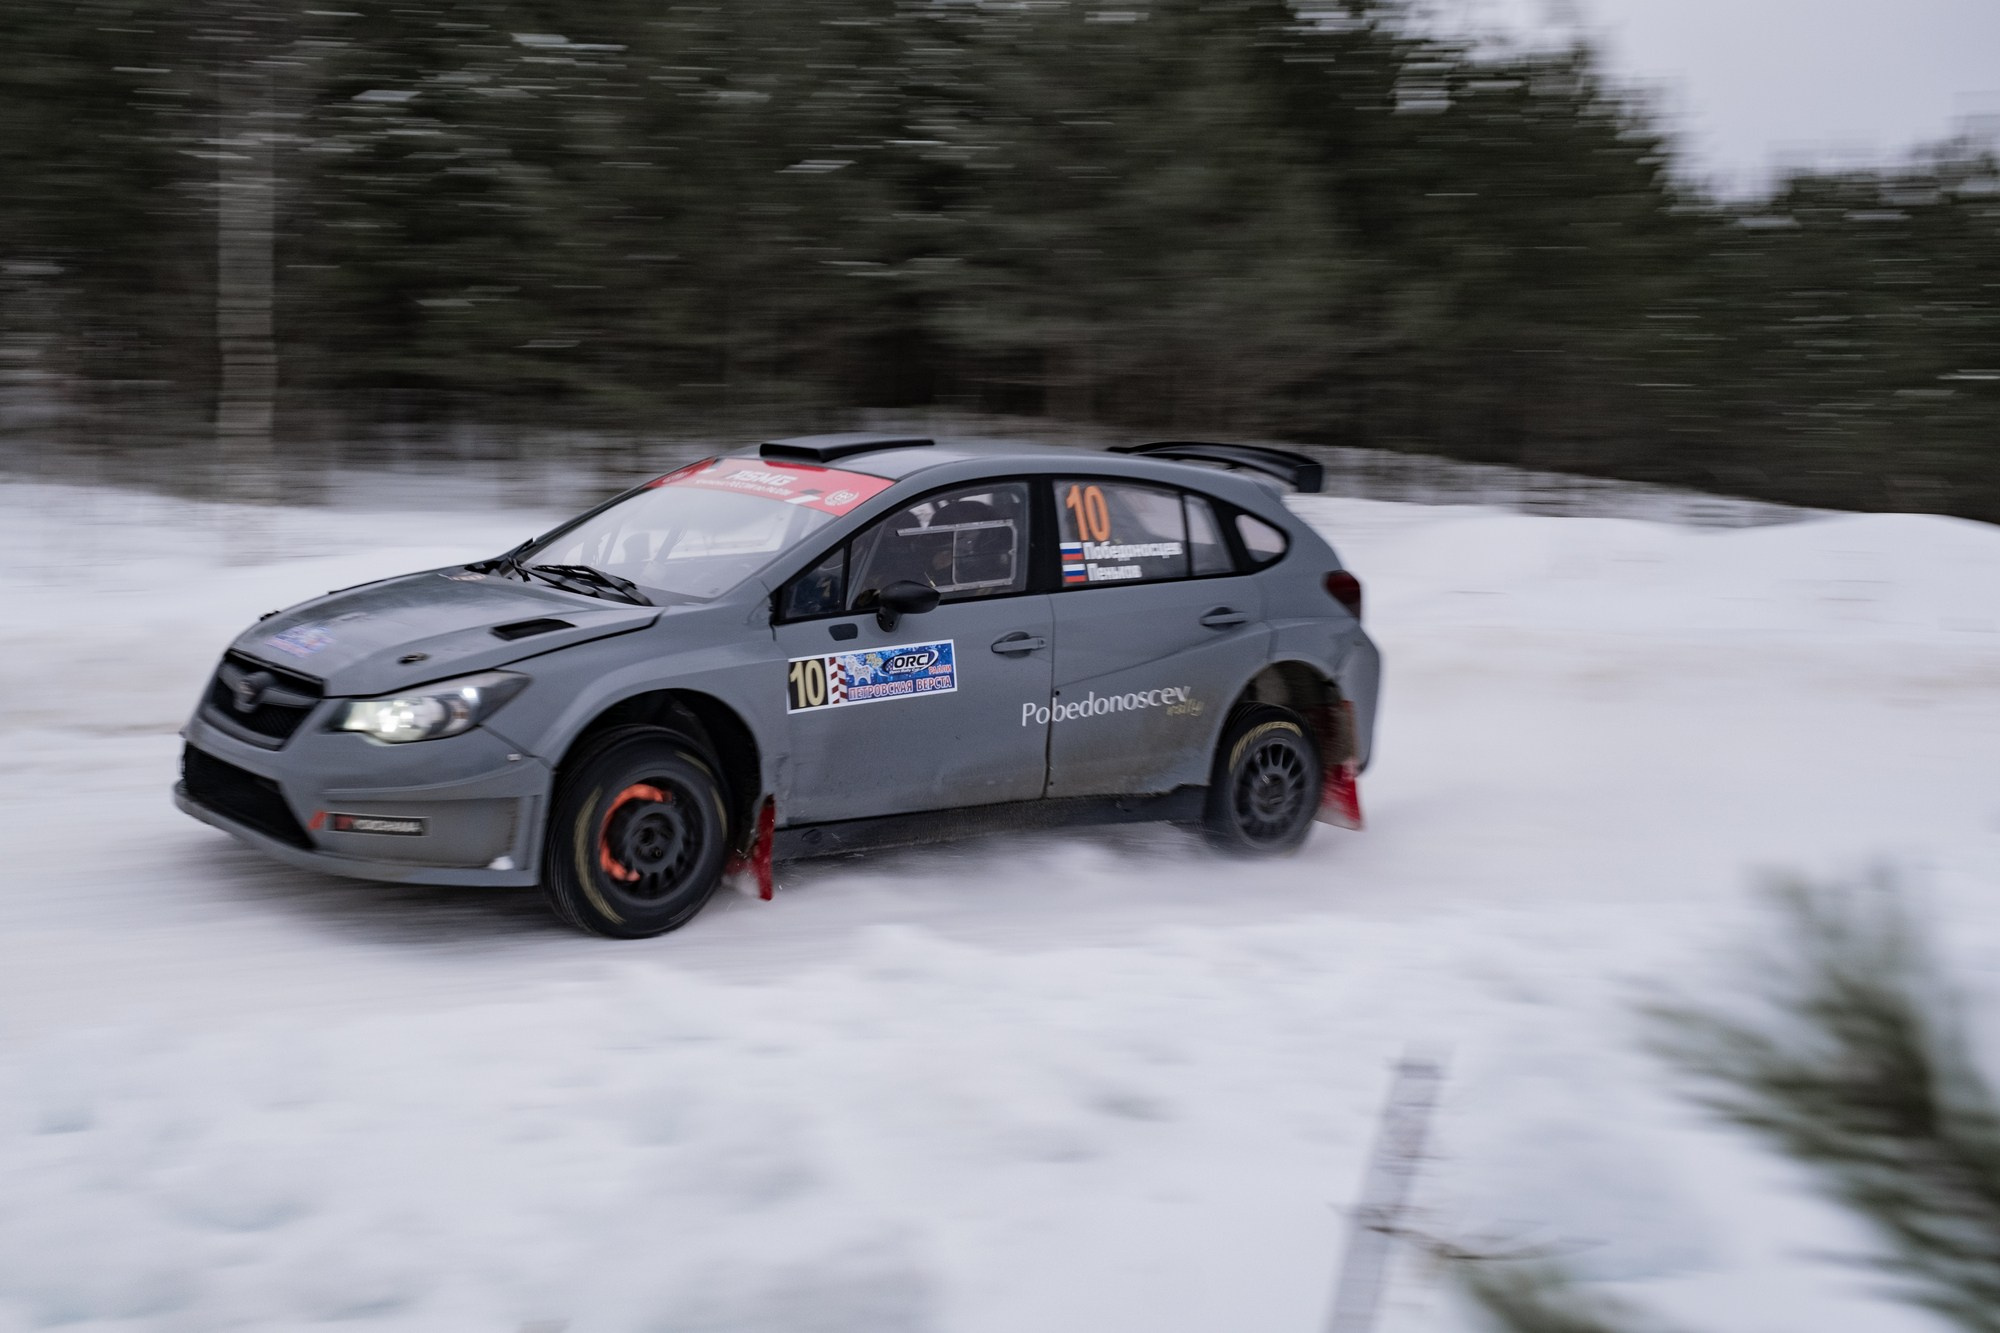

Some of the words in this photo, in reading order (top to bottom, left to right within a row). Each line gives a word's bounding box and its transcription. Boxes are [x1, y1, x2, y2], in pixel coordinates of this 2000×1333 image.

[1065, 484, 1111, 542] 10
[894, 653, 928, 669] ORC
[789, 659, 826, 708] 10
[848, 680, 914, 701] ПЕТРОВСКАЯ
[916, 675, 953, 692] ВЕРСТА
[1021, 686, 1191, 727] Pobedonoscev
